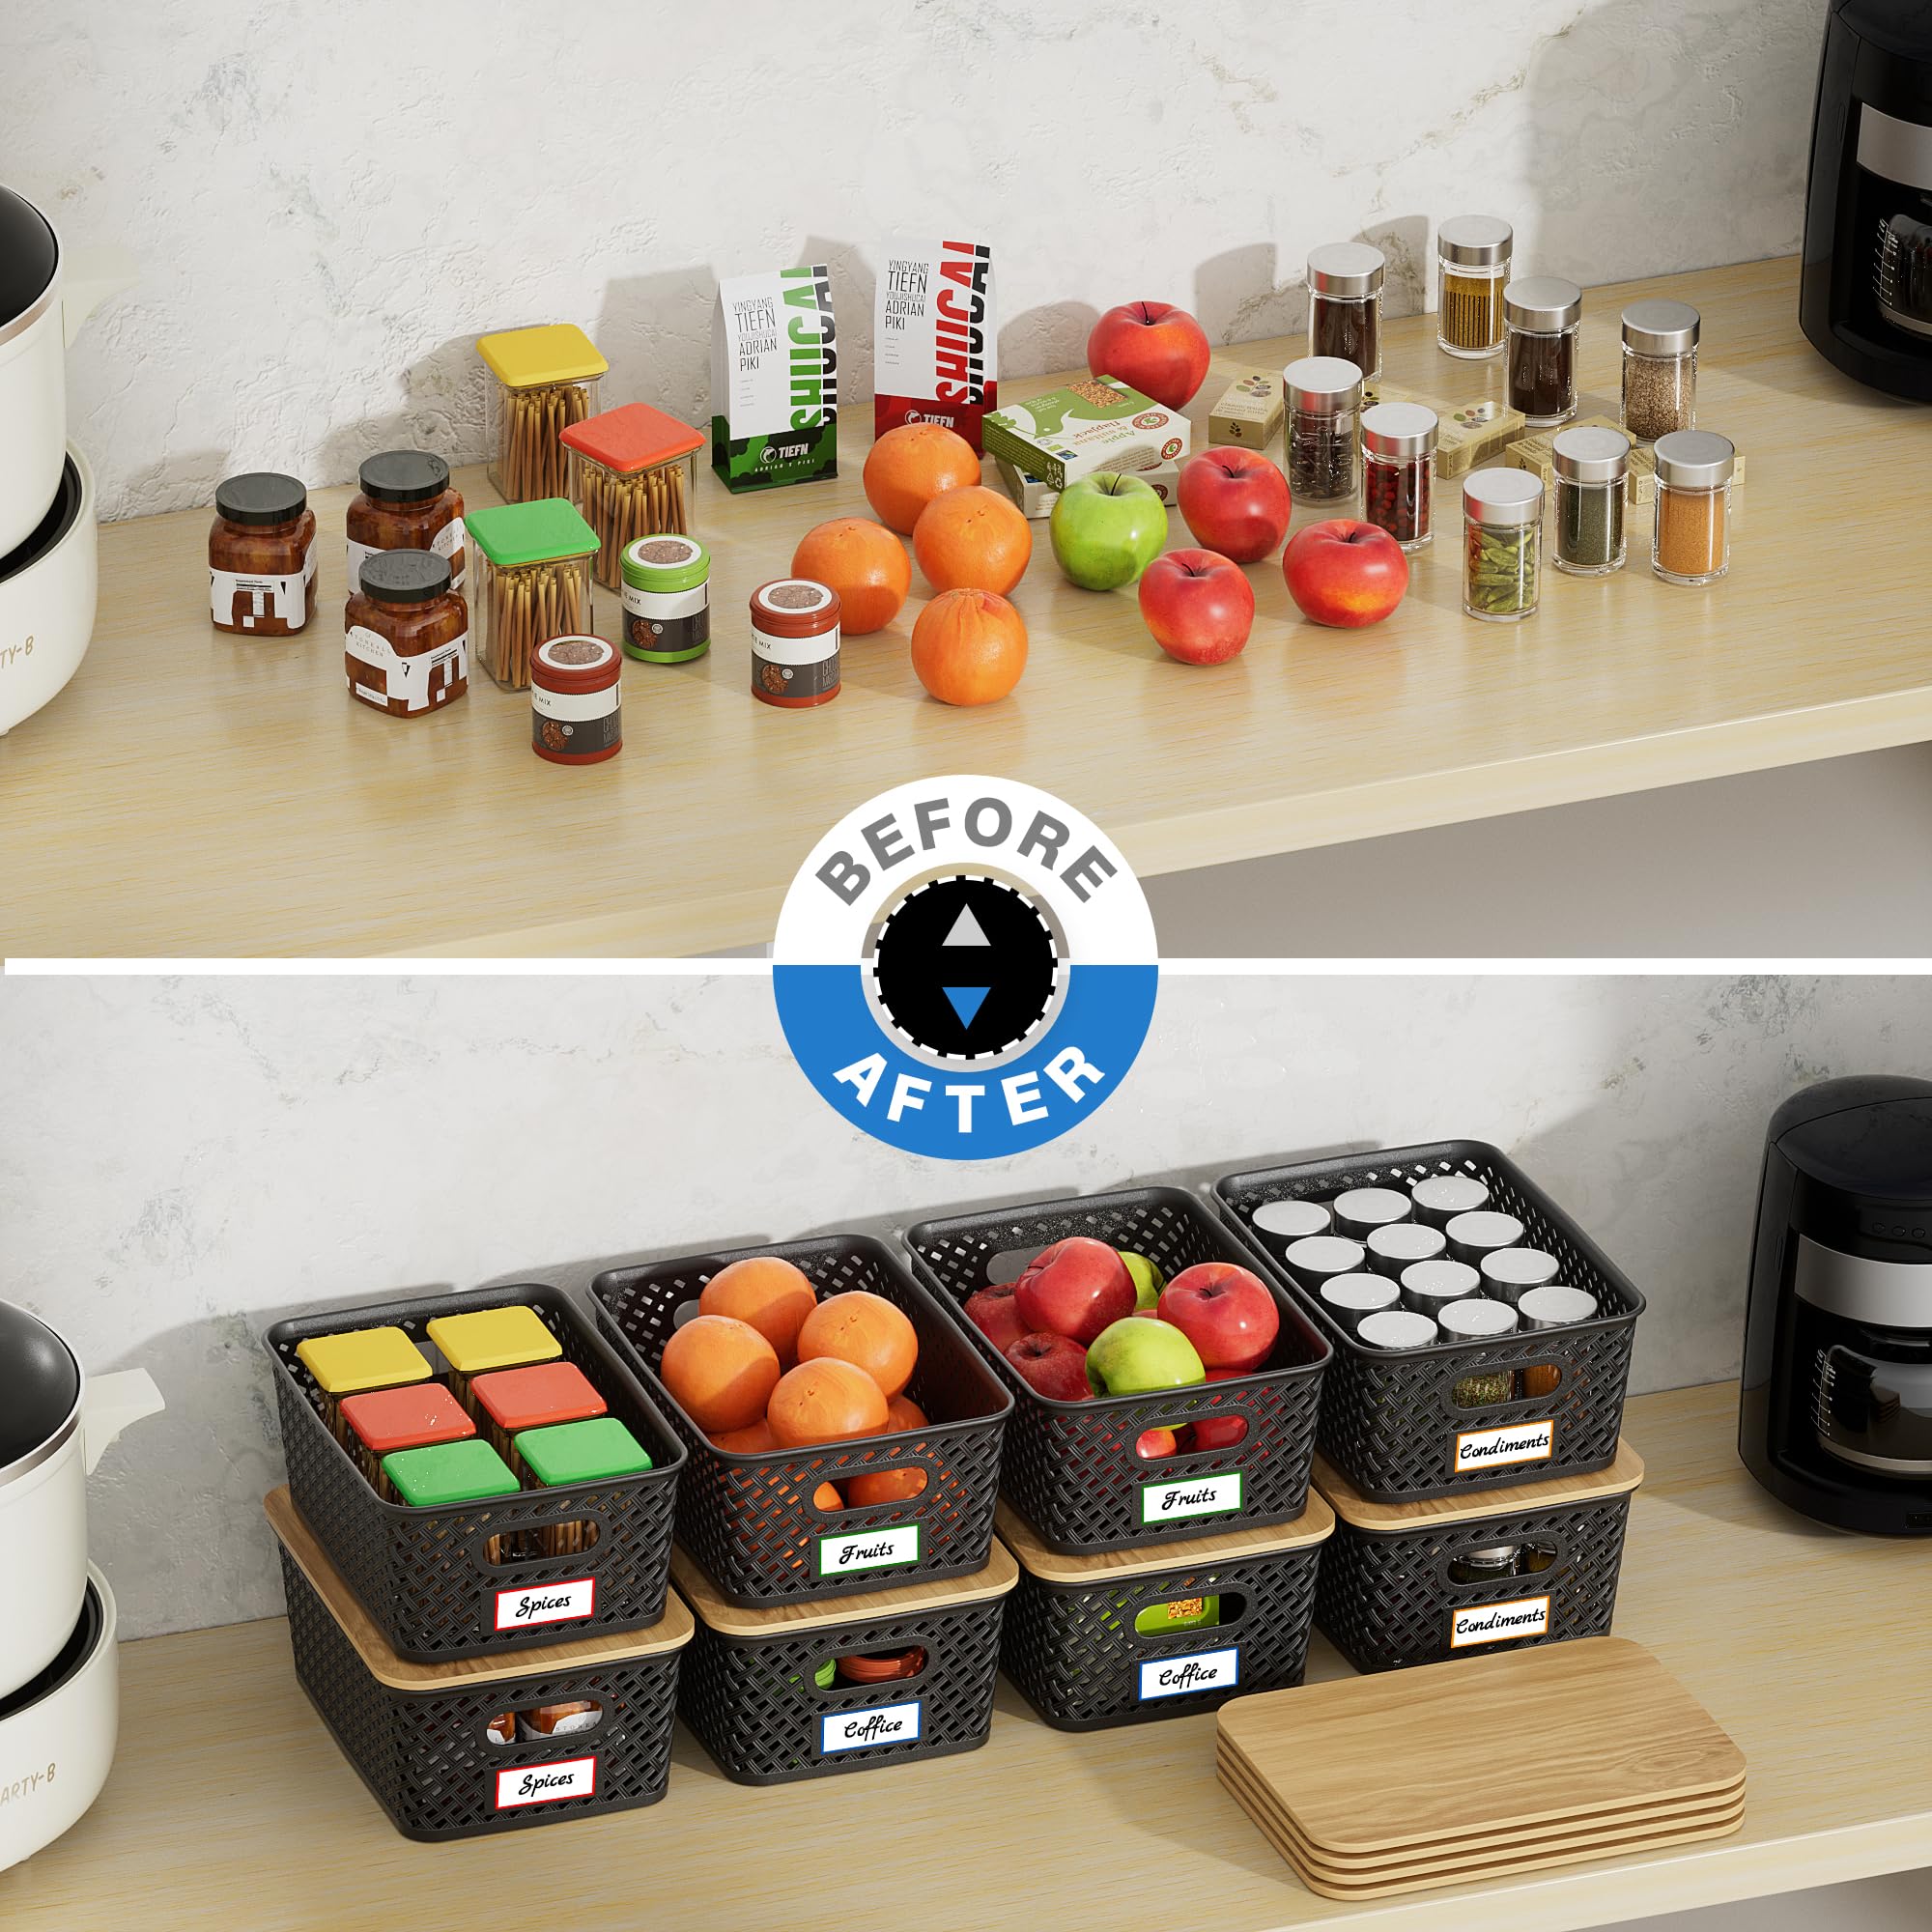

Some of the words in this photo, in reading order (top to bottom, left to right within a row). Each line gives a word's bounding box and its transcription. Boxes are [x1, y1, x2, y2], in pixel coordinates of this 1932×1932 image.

[889, 259, 929, 274] YINGYANG
[888, 270, 927, 294] TIEFN
[732, 297, 774, 313] YINGYANG
[885, 299, 924, 317] ADRIAN
[734, 307, 776, 333] TIEFN
[885, 315, 905, 330] PIKI
[935, 241, 990, 405] SHUCAI
[739, 337, 778, 356] ADRIAN
[781, 266, 838, 430] SHUCAI
[740, 356, 759, 372] PIKI
[923, 413, 954, 428] TIEFN
[778, 442, 810, 459] TIEFN
[628, 595, 641, 606] MIX
[758, 640, 772, 650] MIX
[538, 696, 552, 707] MIX
[1460, 1434, 1550, 1460] Condiments
[1161, 1488, 1217, 1511] Fruits
[838, 1542, 895, 1565] Fruits
[515, 1596, 572, 1619] Spices
[1456, 1608, 1547, 1634] Condiments
[1159, 1662, 1218, 1690] Coffice
[844, 1715, 903, 1742] Coffice
[0, 1762, 56, 1806] ARTY-B
[518, 1774, 575, 1797] Spices
